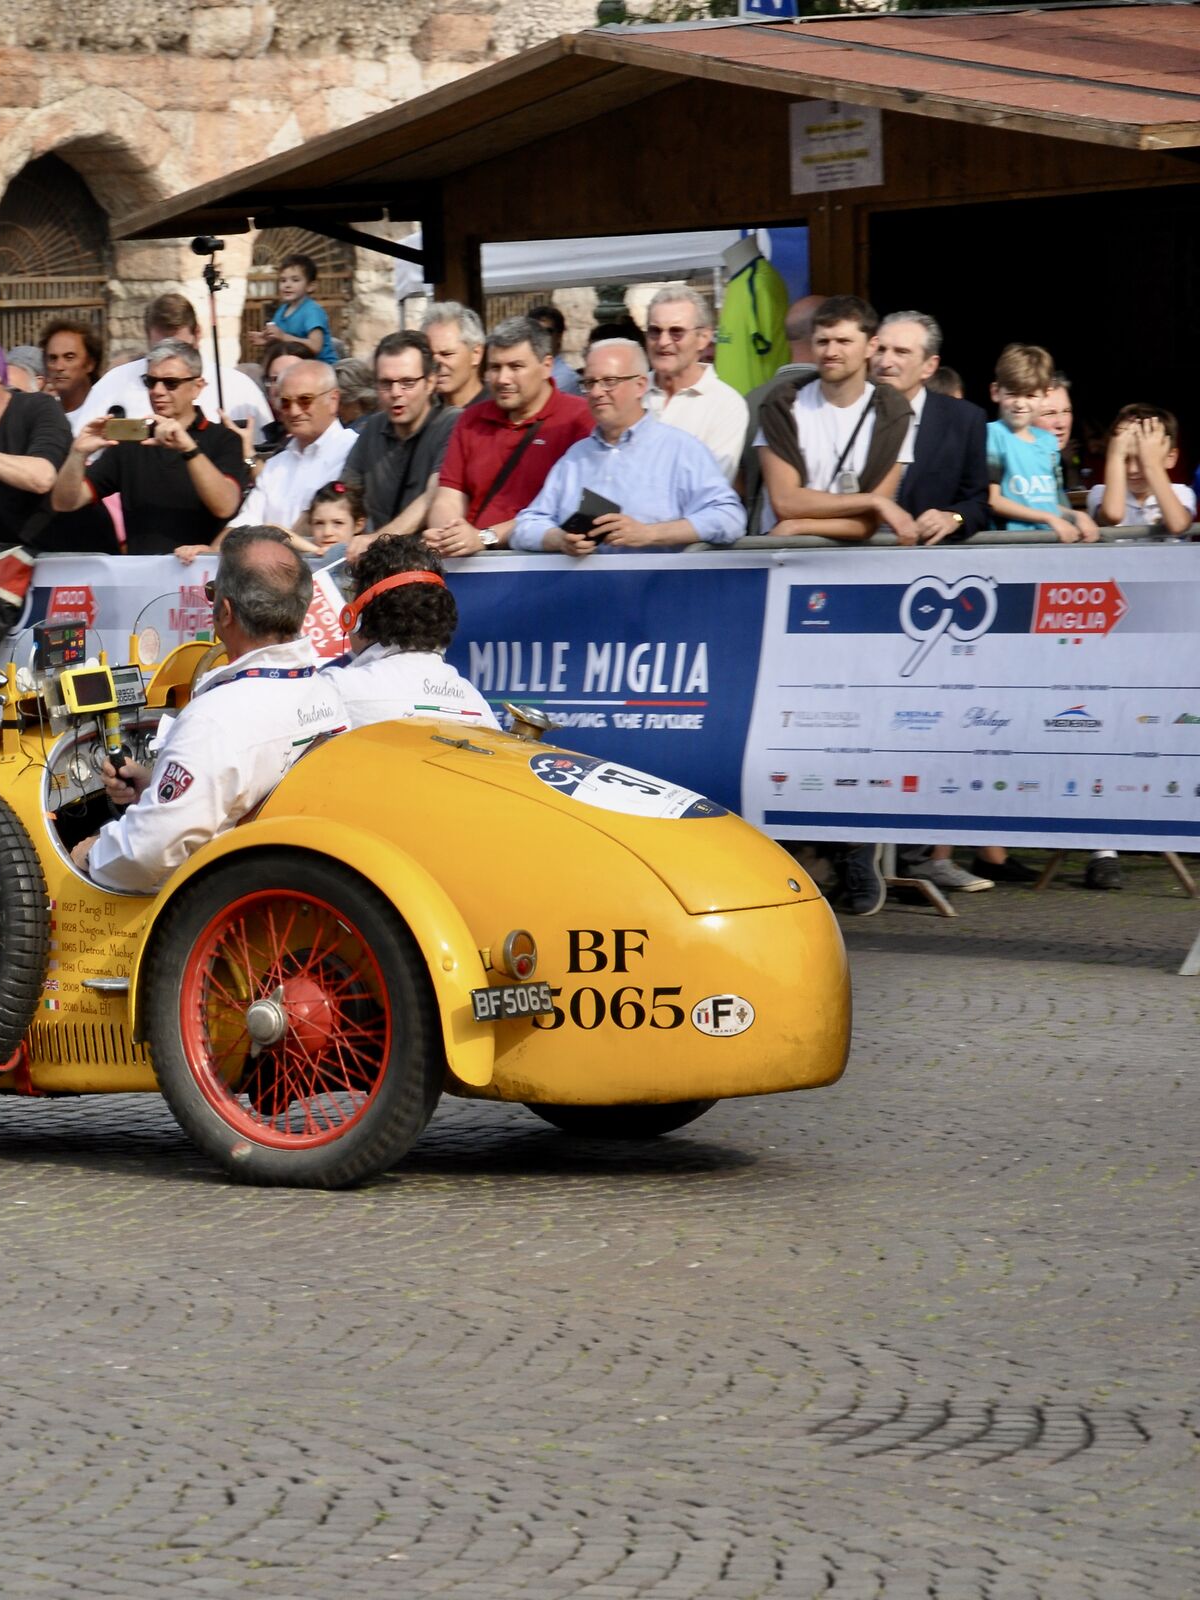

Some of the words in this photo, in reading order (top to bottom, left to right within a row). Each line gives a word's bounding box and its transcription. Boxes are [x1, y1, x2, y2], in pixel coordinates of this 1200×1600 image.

[56, 591, 86, 605] 1000
[1047, 588, 1106, 605] 1000
[1039, 611, 1107, 629] MIGLIA
[469, 641, 570, 692] MILLE
[582, 642, 709, 693] MIGLIA
[423, 678, 465, 699] Scuderia
[297, 702, 335, 727] Scuderia
[644, 714, 705, 730] FUTURE
[166, 763, 192, 787] BNC
[62, 903, 77, 913] 1927
[104, 903, 116, 916] EU
[62, 921, 77, 932] 1928
[108, 922, 138, 939] Vietnam
[62, 941, 77, 952] 1965
[566, 929, 650, 973] BF
[62, 982, 81, 993] 2008
[532, 985, 685, 1031] 5065
[712, 998, 733, 1029] F
